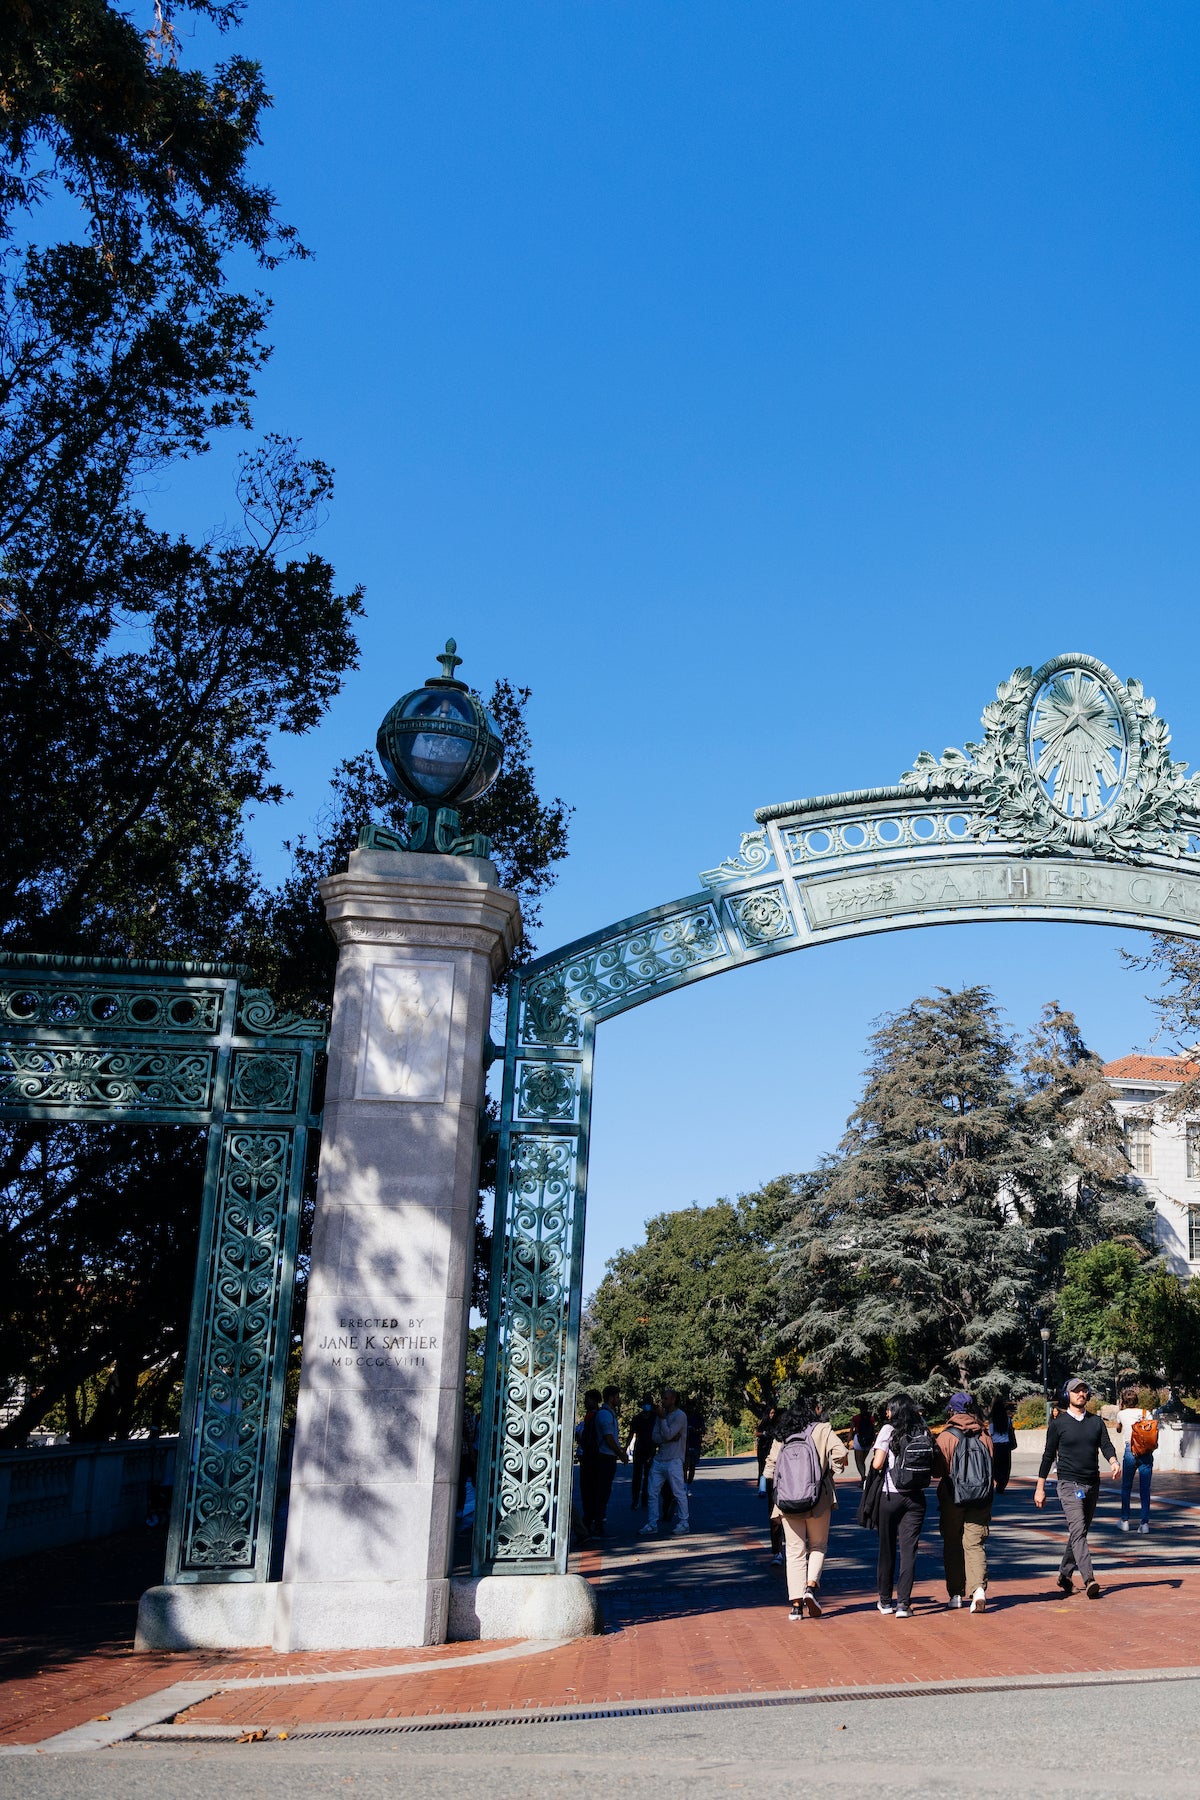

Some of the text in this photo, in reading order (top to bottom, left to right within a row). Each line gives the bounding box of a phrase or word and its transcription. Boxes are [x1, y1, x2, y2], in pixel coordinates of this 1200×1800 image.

[911, 866, 1096, 902] SATHER
[339, 1318, 424, 1328] ERECTED BY
[319, 1336, 438, 1350] JANE K SATHER
